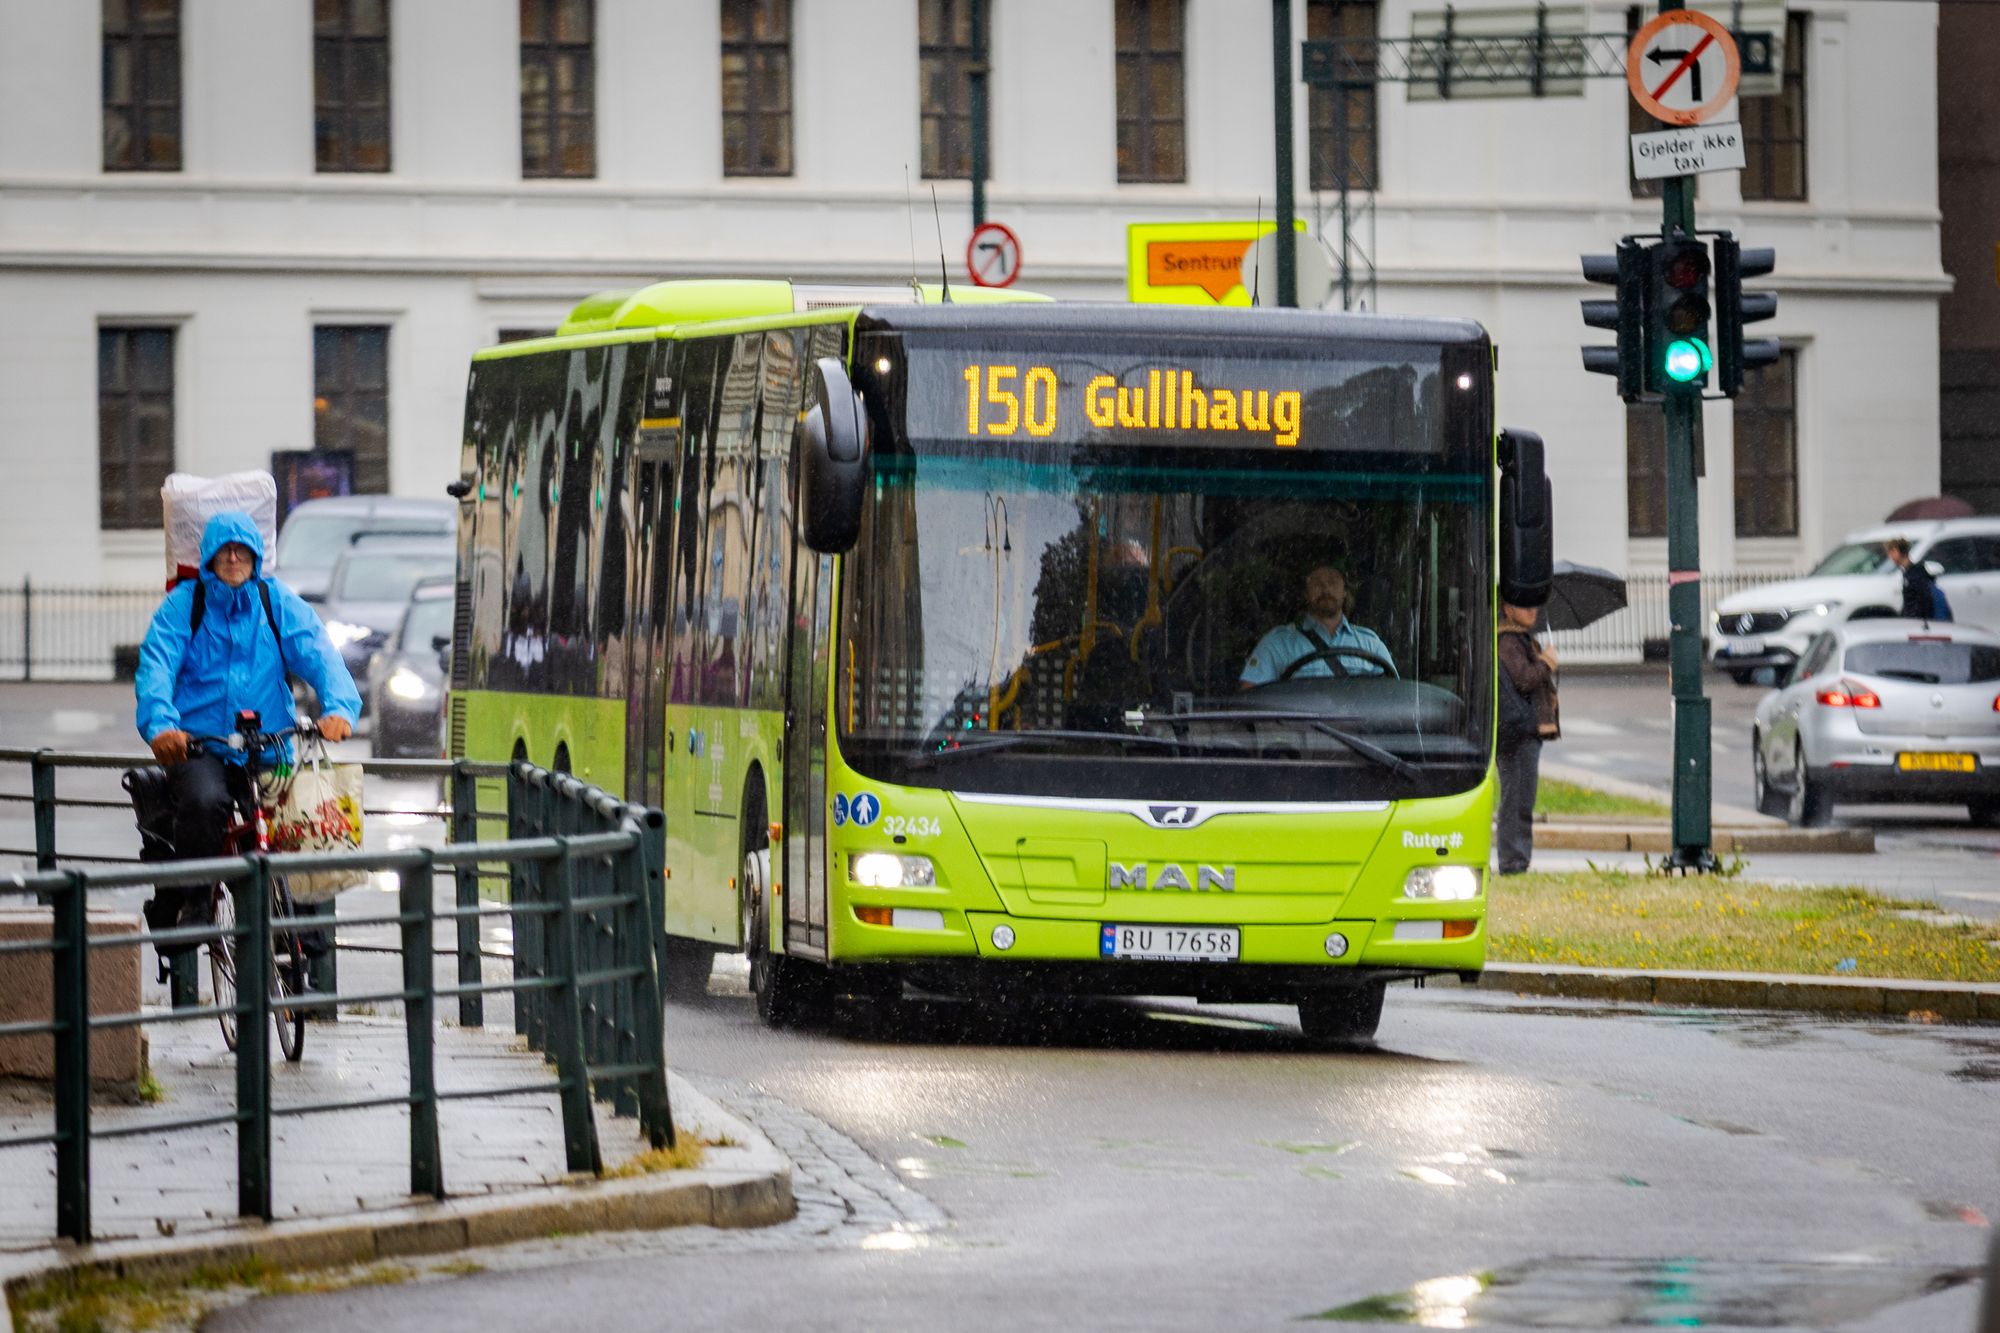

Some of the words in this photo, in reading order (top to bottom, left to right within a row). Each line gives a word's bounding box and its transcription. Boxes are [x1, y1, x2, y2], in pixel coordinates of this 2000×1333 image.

[1639, 139, 1695, 160] Gjelder
[1703, 134, 1736, 150] ikke
[1674, 153, 1705, 171] taxi
[964, 364, 1058, 437] 150
[1085, 370, 1302, 447] Gullhaug
[883, 816, 942, 837] 32434
[1402, 831, 1463, 848] Ruter#
[1110, 863, 1236, 893] MAN
[1122, 929, 1153, 950] BU
[1166, 932, 1232, 953] 17658
